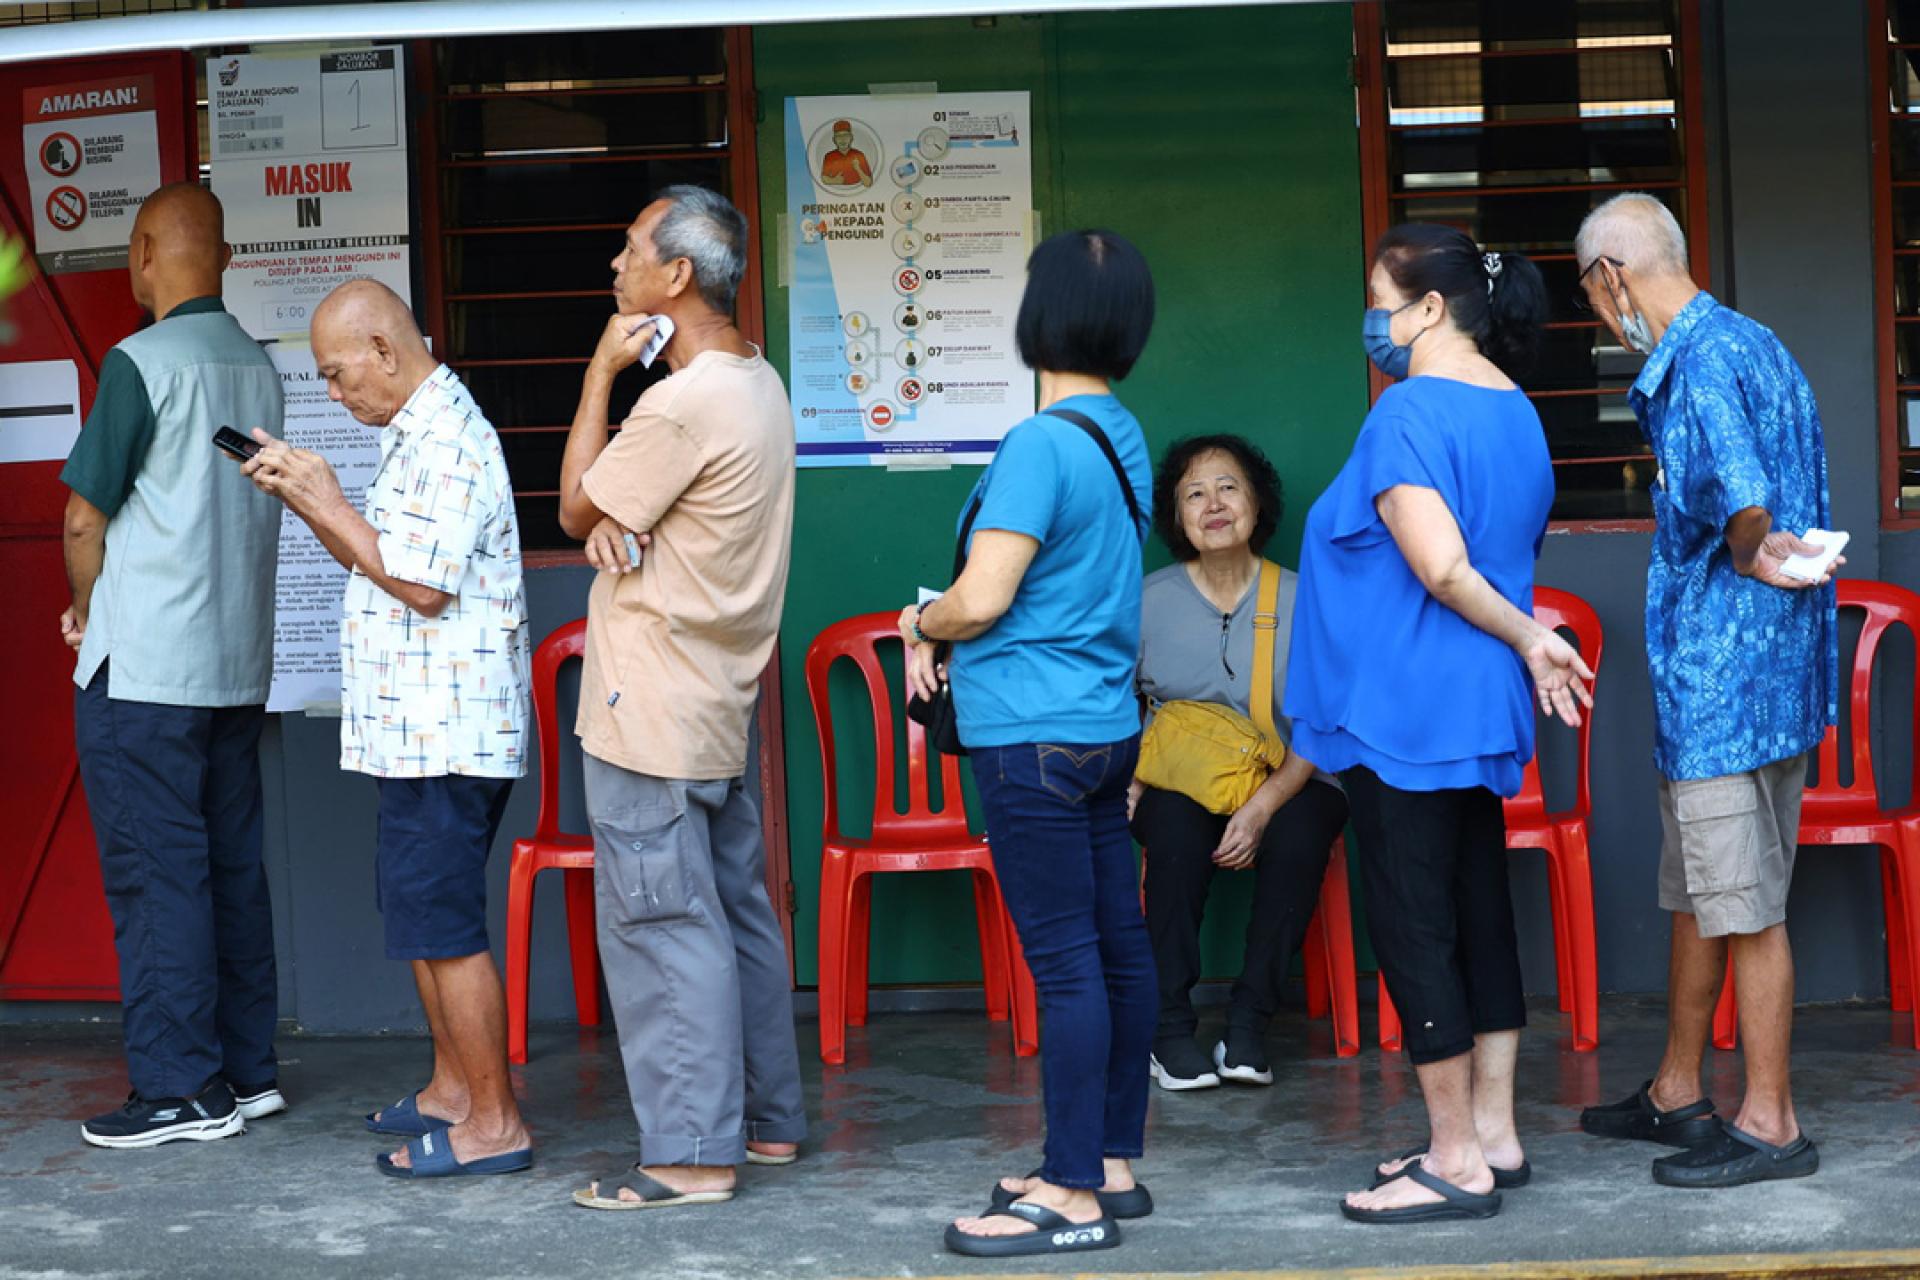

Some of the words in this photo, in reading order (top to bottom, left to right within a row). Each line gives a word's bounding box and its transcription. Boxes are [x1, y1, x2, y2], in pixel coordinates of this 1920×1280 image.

[337, 53, 379, 62] NOMBOR
[336, 61, 376, 70] SALURAN
[217, 89, 249, 99] TEMPAT
[252, 86, 299, 96] MENGUNDI
[40, 87, 138, 113] AMARAN!
[217, 98, 264, 109] (SALURAN)
[347, 79, 371, 131] 1
[933, 111, 947, 122] 01
[84, 135, 124, 146] DILARANG
[85, 144, 124, 155] MEMBUAT
[86, 155, 112, 164] BISING
[924, 165, 940, 176] 02
[265, 162, 352, 196] MASUK
[89, 189, 128, 200] DILARANG
[802, 202, 885, 215] PERINGATAN
[924, 197, 940, 209] 03
[91, 208, 124, 218] TELEFON
[296, 197, 321, 228] IN
[834, 216, 884, 227] KEPADA
[821, 229, 884, 240] PENGUNDI
[924, 232, 942, 243] 04
[288, 257, 297, 266] DI
[299, 256, 333, 266] TEMPAT
[335, 253, 386, 264] MENGUNDI
[388, 252, 401, 260] INI
[268, 266, 302, 277] DITUTUP
[304, 265, 328, 275] PADA
[333, 265, 352, 273] JAM
[925, 269, 943, 280] 05
[254, 278, 285, 287] POLLING
[926, 310, 943, 320] 06
[927, 346, 943, 357] 07
[927, 382, 944, 393] 08
[801, 407, 817, 418] 09
